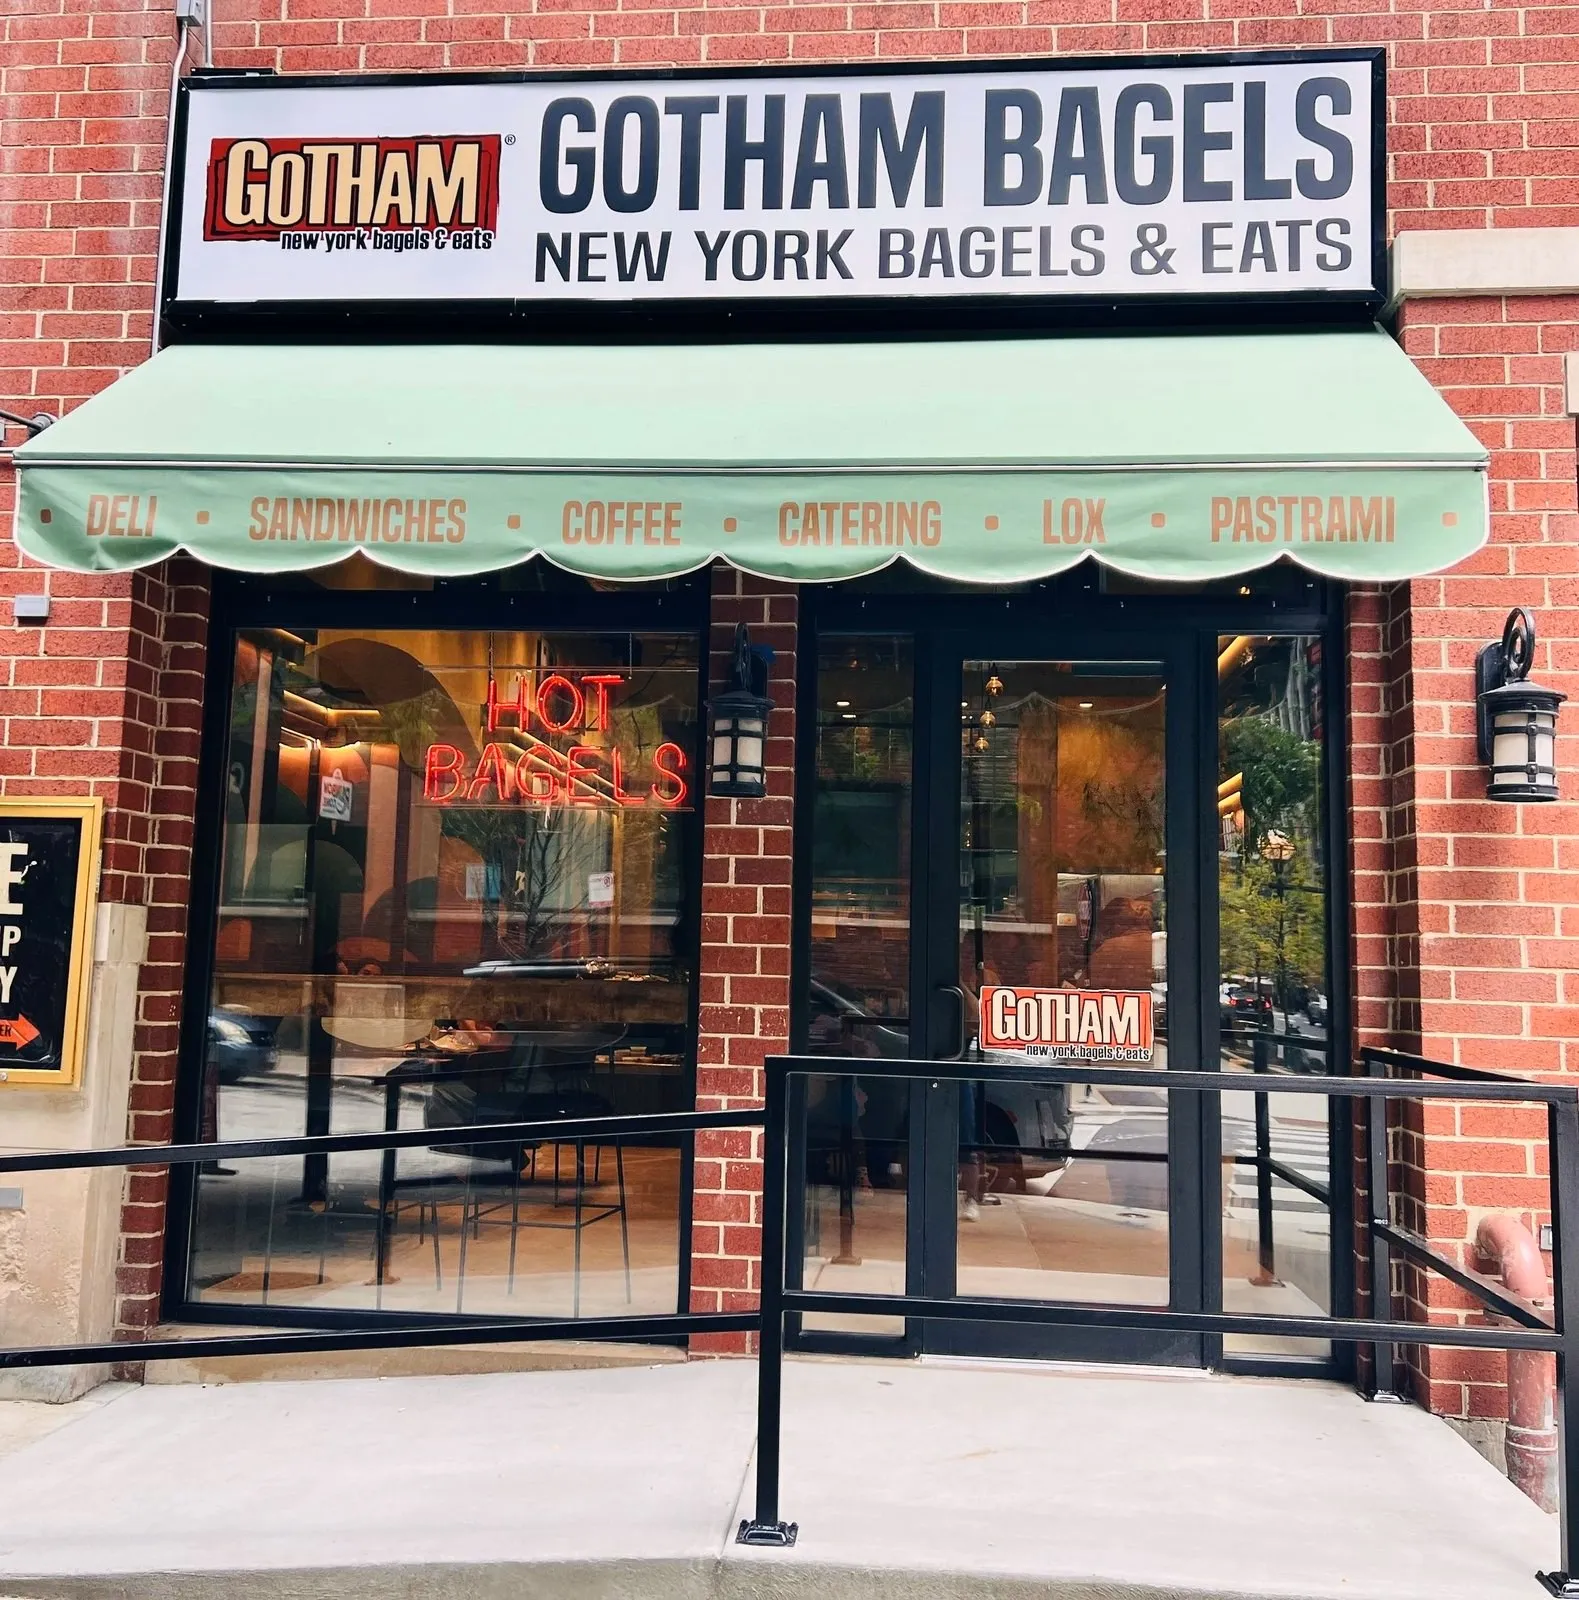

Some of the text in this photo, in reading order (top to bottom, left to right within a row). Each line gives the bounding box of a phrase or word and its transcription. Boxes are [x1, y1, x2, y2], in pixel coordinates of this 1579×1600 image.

[540, 77, 1354, 213] GOTHAM BAGELS
[281, 230, 492, 253] new york bagels & eats
[535, 218, 1352, 282] NEW YORK BAGELS & EATS
[86, 495, 1395, 547] DELI SANDWICHES COFFEE CATERING LOX PASTRAMI
[486, 674, 625, 733] HOT
[423, 742, 688, 805] BAGELS
[1026, 1045, 1149, 1060] new york bagels & eats
